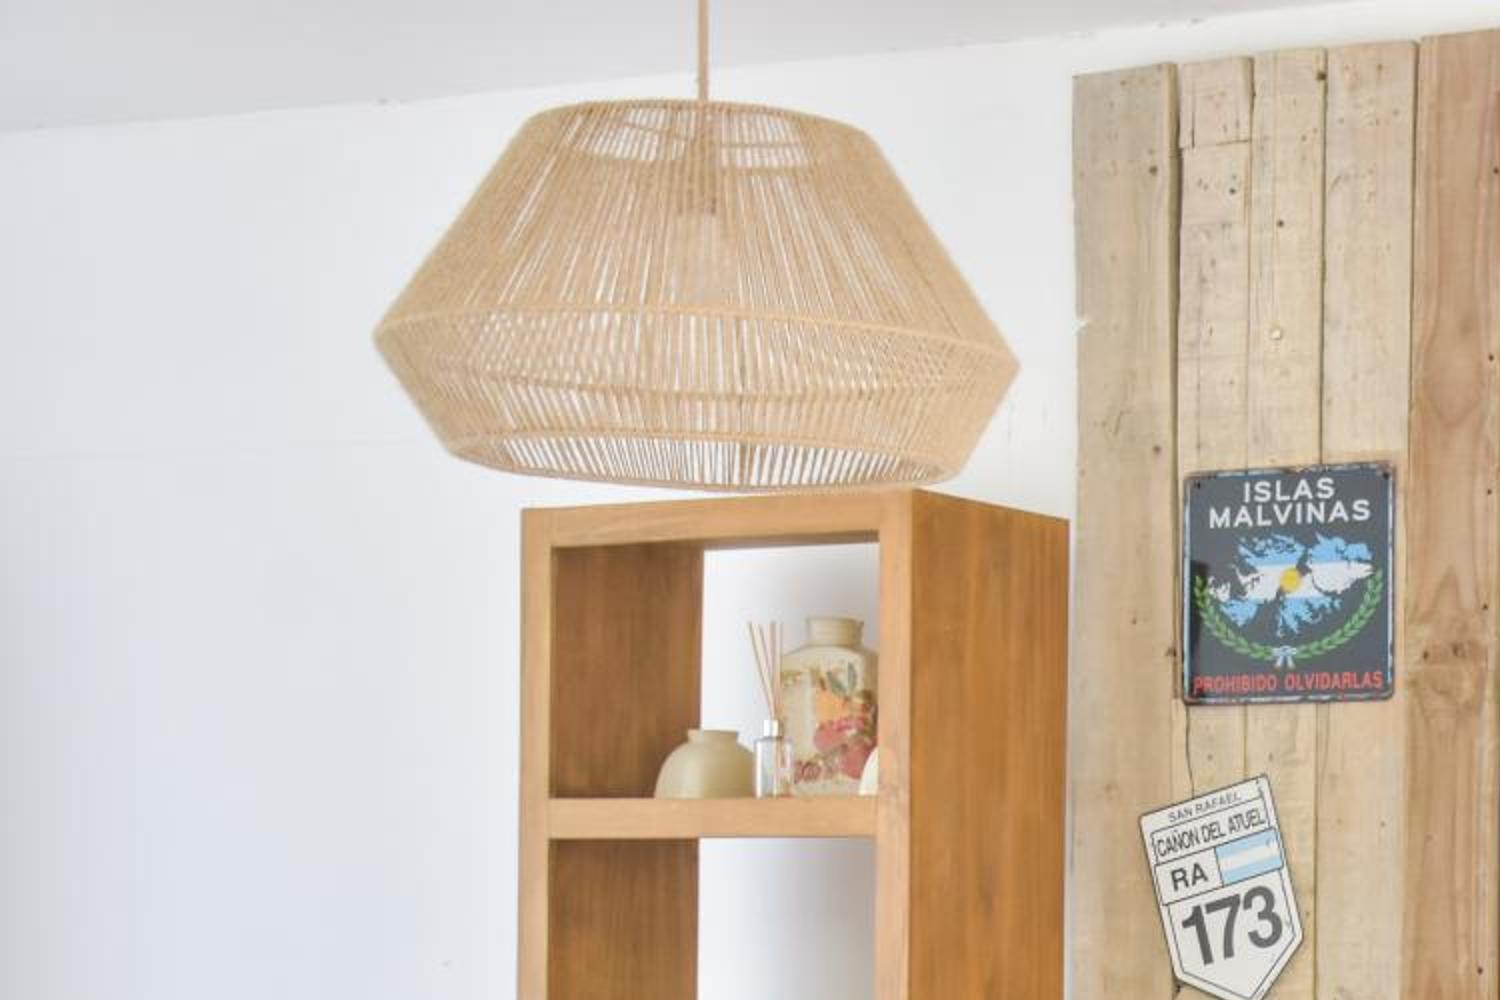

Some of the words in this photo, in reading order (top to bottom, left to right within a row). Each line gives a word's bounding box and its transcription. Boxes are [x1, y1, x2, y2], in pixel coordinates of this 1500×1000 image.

[1244, 477, 1335, 503] ISLAS
[1209, 499, 1371, 529] MALVINAS
[1193, 674, 1277, 695] PROHIBIDO
[1284, 671, 1383, 691] OLVIDARLAS
[1168, 807, 1193, 822] SAN
[1195, 791, 1243, 814] RAFAEL
[1201, 820, 1226, 843] DEL
[1228, 808, 1266, 834] ATUEL
[1171, 862, 1208, 892] RA
[1182, 885, 1283, 966] 173
